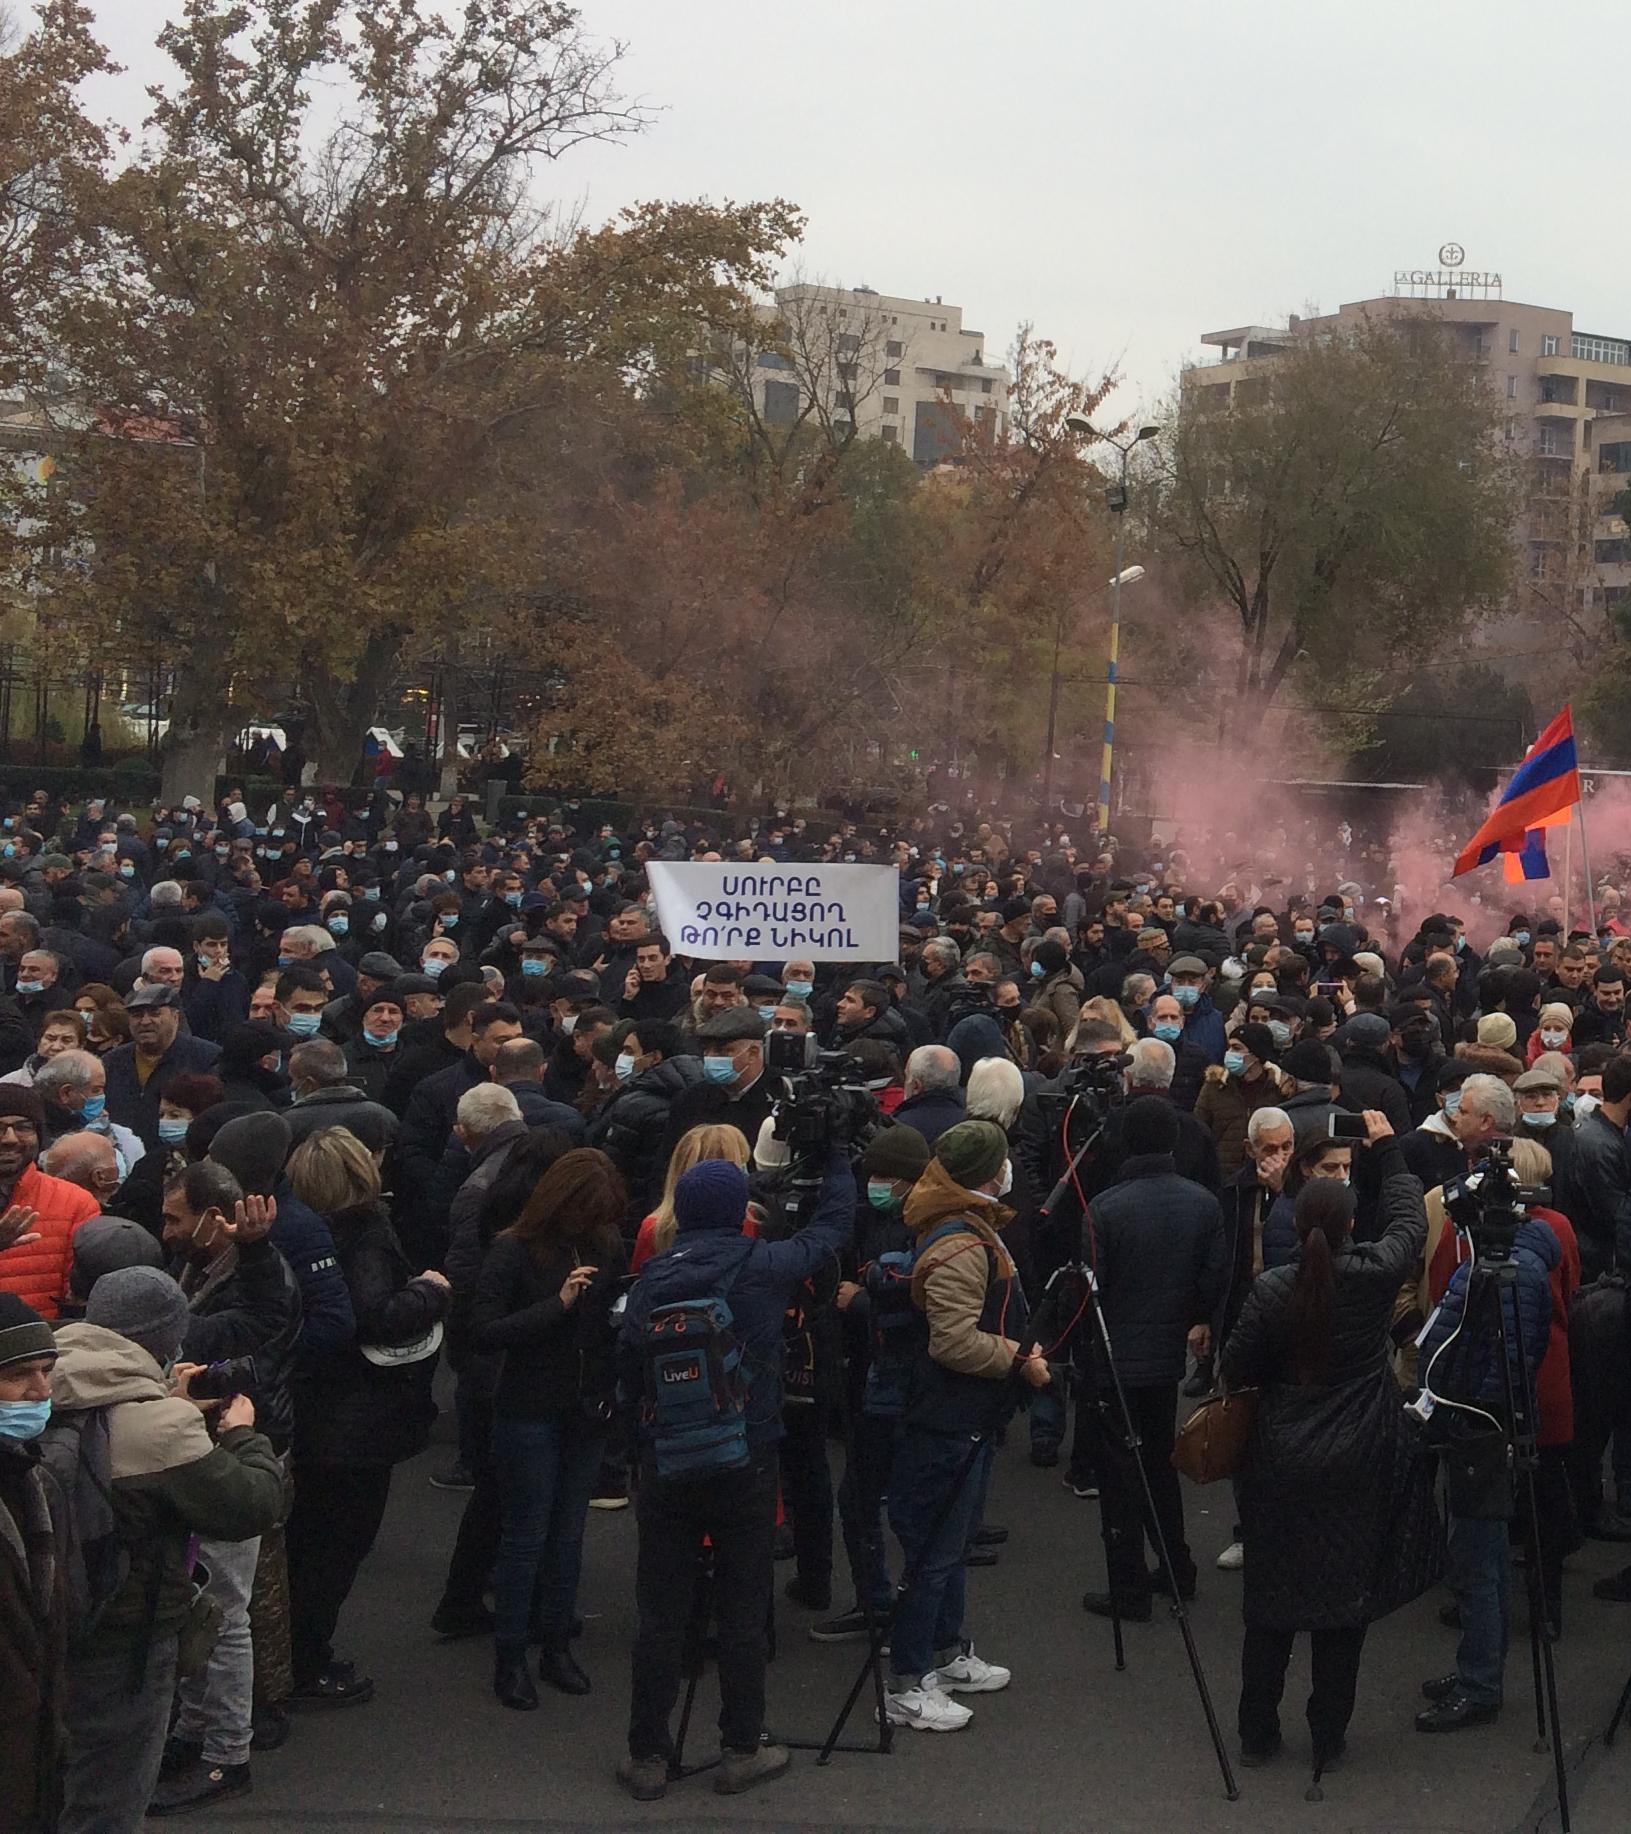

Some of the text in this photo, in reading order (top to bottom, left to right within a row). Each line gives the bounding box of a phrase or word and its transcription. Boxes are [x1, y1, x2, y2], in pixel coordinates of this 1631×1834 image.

[1410, 270, 1502, 287] GALLERIA
[722, 875, 821, 897] ՍՈՒՐԲԸ
[695, 901, 846, 923] ՉԳԻԴԱՑՈՂ
[770, 926, 860, 948] ՆԻԿՈԼ
